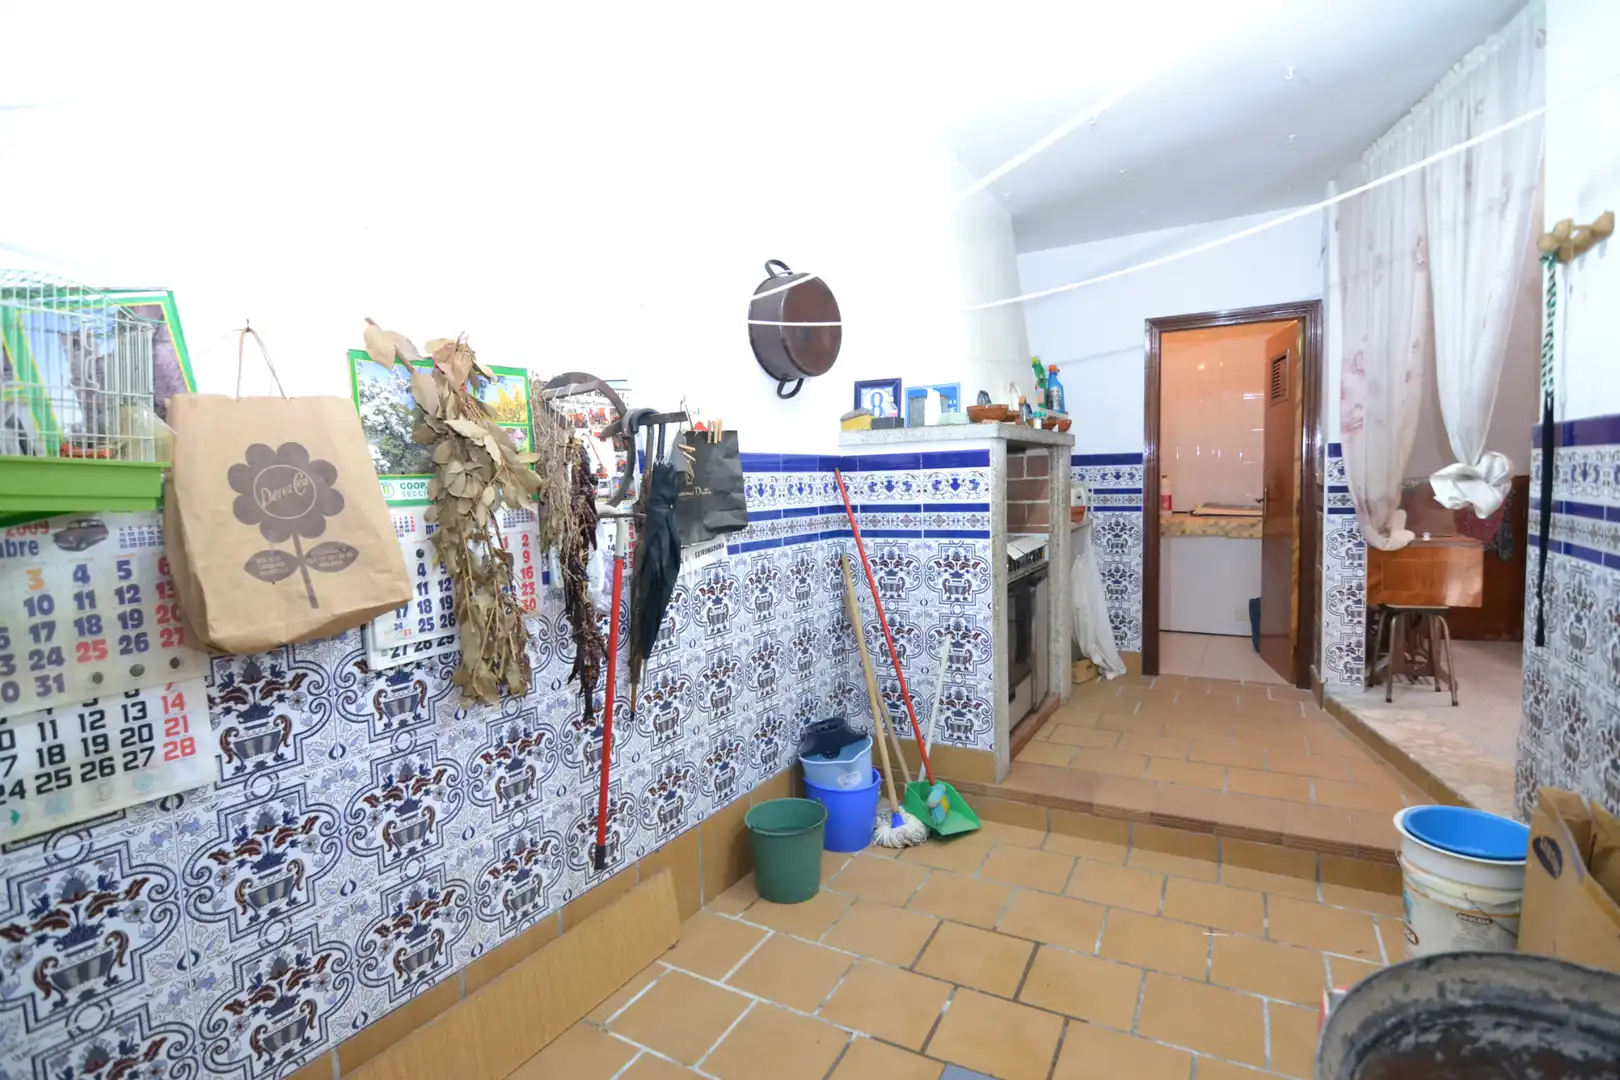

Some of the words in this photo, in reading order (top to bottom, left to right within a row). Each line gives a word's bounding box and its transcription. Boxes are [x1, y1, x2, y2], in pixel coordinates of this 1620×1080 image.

[401, 490, 428, 498] SECCI
[522, 534, 529, 547] 2
[523, 550, 531, 563] 9
[26, 568, 45, 591] 3
[73, 564, 91, 584] 4
[116, 559, 133, 580] 5
[417, 563, 427, 577] 4
[521, 566, 534, 579] 16
[417, 581, 429, 596] 11
[438, 577, 452, 592] 12
[521, 582, 535, 597] 23
[23, 594, 55, 617] 10
[73, 589, 97, 611] 11
[114, 584, 142, 605] 12
[417, 598, 432, 614] 18
[439, 595, 454, 610] 19
[29, 620, 56, 643] 17
[73, 614, 103, 636] 18
[117, 608, 144, 630] 19
[418, 616, 435, 633] 25
[440, 612, 457, 628] 26
[29, 646, 66, 671] 24
[75, 638, 109, 663] 25
[119, 632, 149, 655] 26
[159, 627, 185, 648] 27
[35, 673, 66, 697] 31
[38, 719, 58, 742] 11
[78, 709, 107, 733] 12
[121, 700, 147, 723] 13
[161, 692, 186, 715] 14
[36, 743, 66, 768] 18
[81, 733, 110, 757] 19
[119, 723, 154, 748] 20
[164, 715, 190, 737] 21
[34, 766, 73, 796] 25
[79, 756, 116, 783] 26
[122, 745, 155, 772] 27
[163, 736, 197, 762] 28
